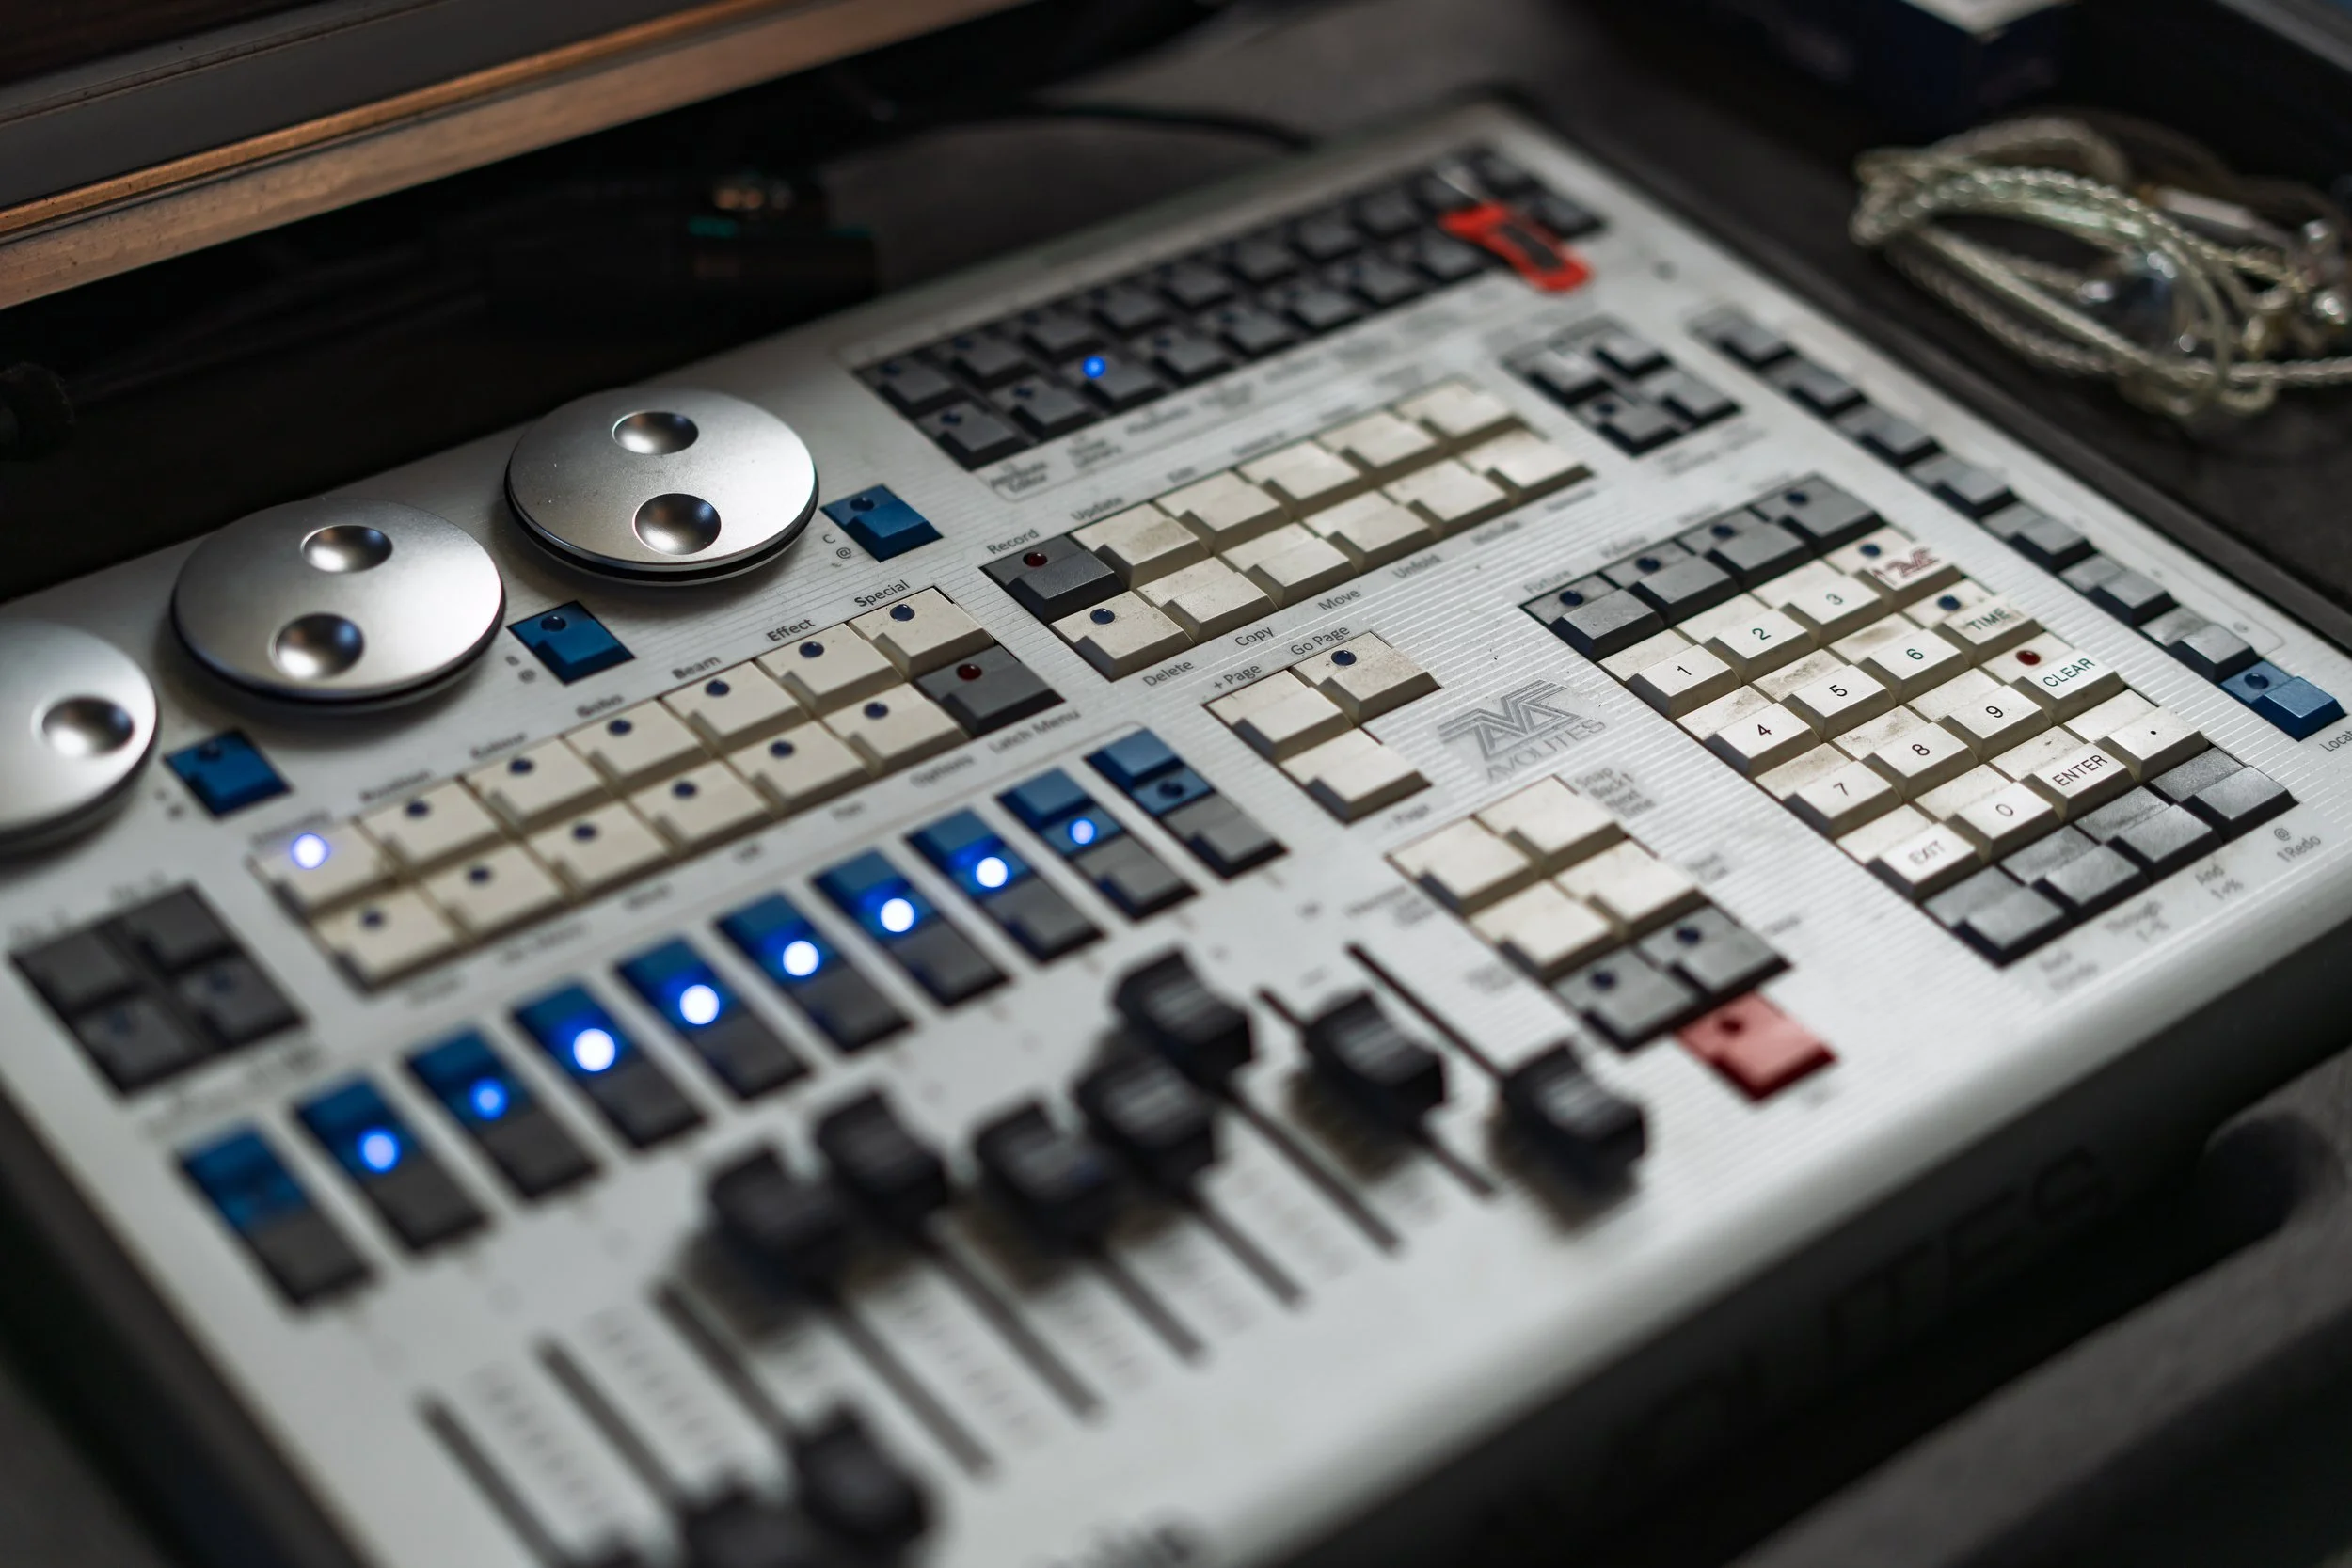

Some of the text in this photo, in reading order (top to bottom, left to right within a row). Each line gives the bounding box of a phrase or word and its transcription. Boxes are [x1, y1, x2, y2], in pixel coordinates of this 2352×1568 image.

[986, 529, 1041, 555] Record
[1523, 567, 1573, 594] Fixture
[853, 579, 911, 609] Special
[1317, 589, 1361, 611] Move
[1825, 593, 1844, 606] 3
[766, 618, 817, 643] Effect
[1965, 607, 2012, 631] TIME
[1234, 626, 1276, 648] Copy
[1290, 625, 1351, 657] Go Page
[1752, 627, 1771, 641] 2
[1906, 648, 1924, 660] 6
[672, 657, 722, 681] Beam
[1141, 658, 1195, 688] Delete
[1225, 662, 1263, 686] Page
[1677, 665, 1692, 676] 1
[2042, 657, 2096, 688] CLEAR
[1829, 684, 1848, 697] 5
[1985, 705, 2004, 718] 9
[988, 709, 1081, 755] Latch Menu
[1757, 723, 1772, 736] 4
[1485, 719, 1607, 783] AVOLITES
[1912, 743, 1931, 756] 8
[2052, 754, 2108, 787] ENTER
[1833, 782, 1849, 797] 7
[1995, 803, 2014, 817] 0
[1908, 839, 1947, 866] EXIT
